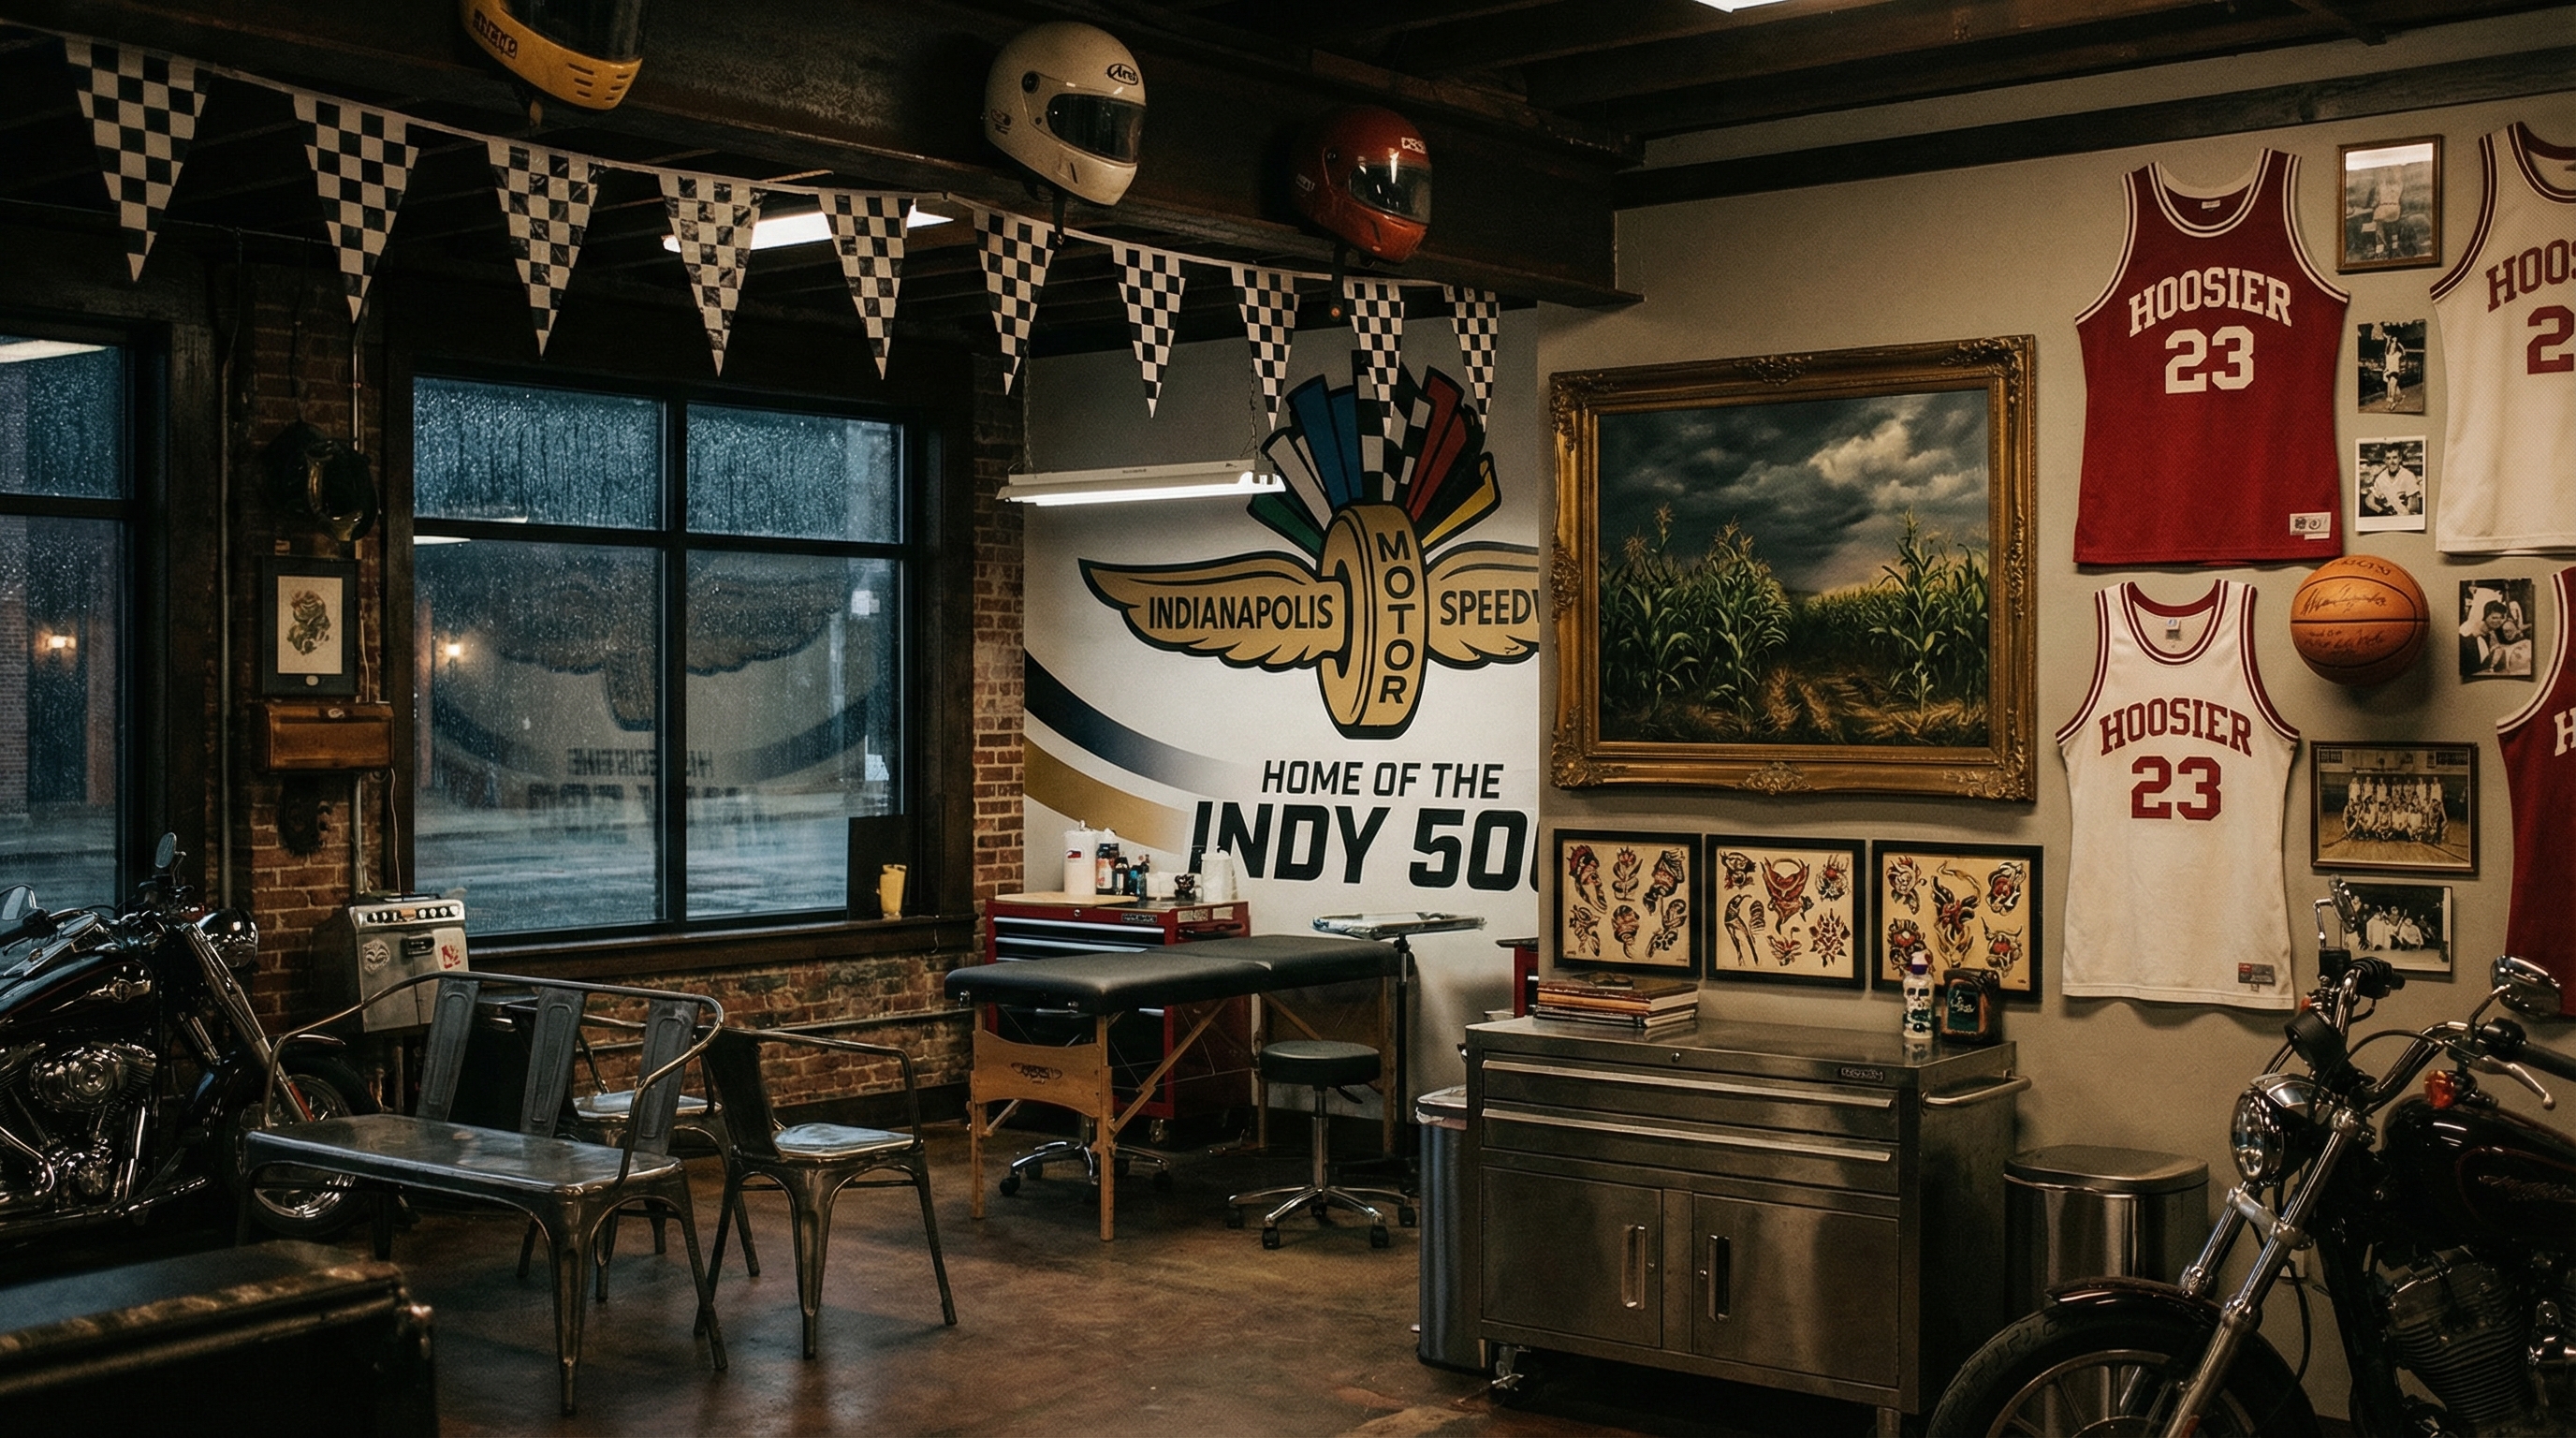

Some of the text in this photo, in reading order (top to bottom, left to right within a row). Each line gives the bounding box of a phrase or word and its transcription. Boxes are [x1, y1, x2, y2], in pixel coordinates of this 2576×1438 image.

[2129, 267, 2291, 337] HOOSIER
[2165, 326, 2254, 394] 23
[2527, 305, 2574, 374] 2
[1149, 594, 1333, 629] INDIANAPOLIS
[1377, 531, 1415, 704] MOTOR
[2100, 697, 2252, 756] HOOSIER
[1262, 760, 1503, 799] HOME OF THE
[2131, 756, 2221, 820] 23
[1188, 800, 1539, 892] INDY 50
